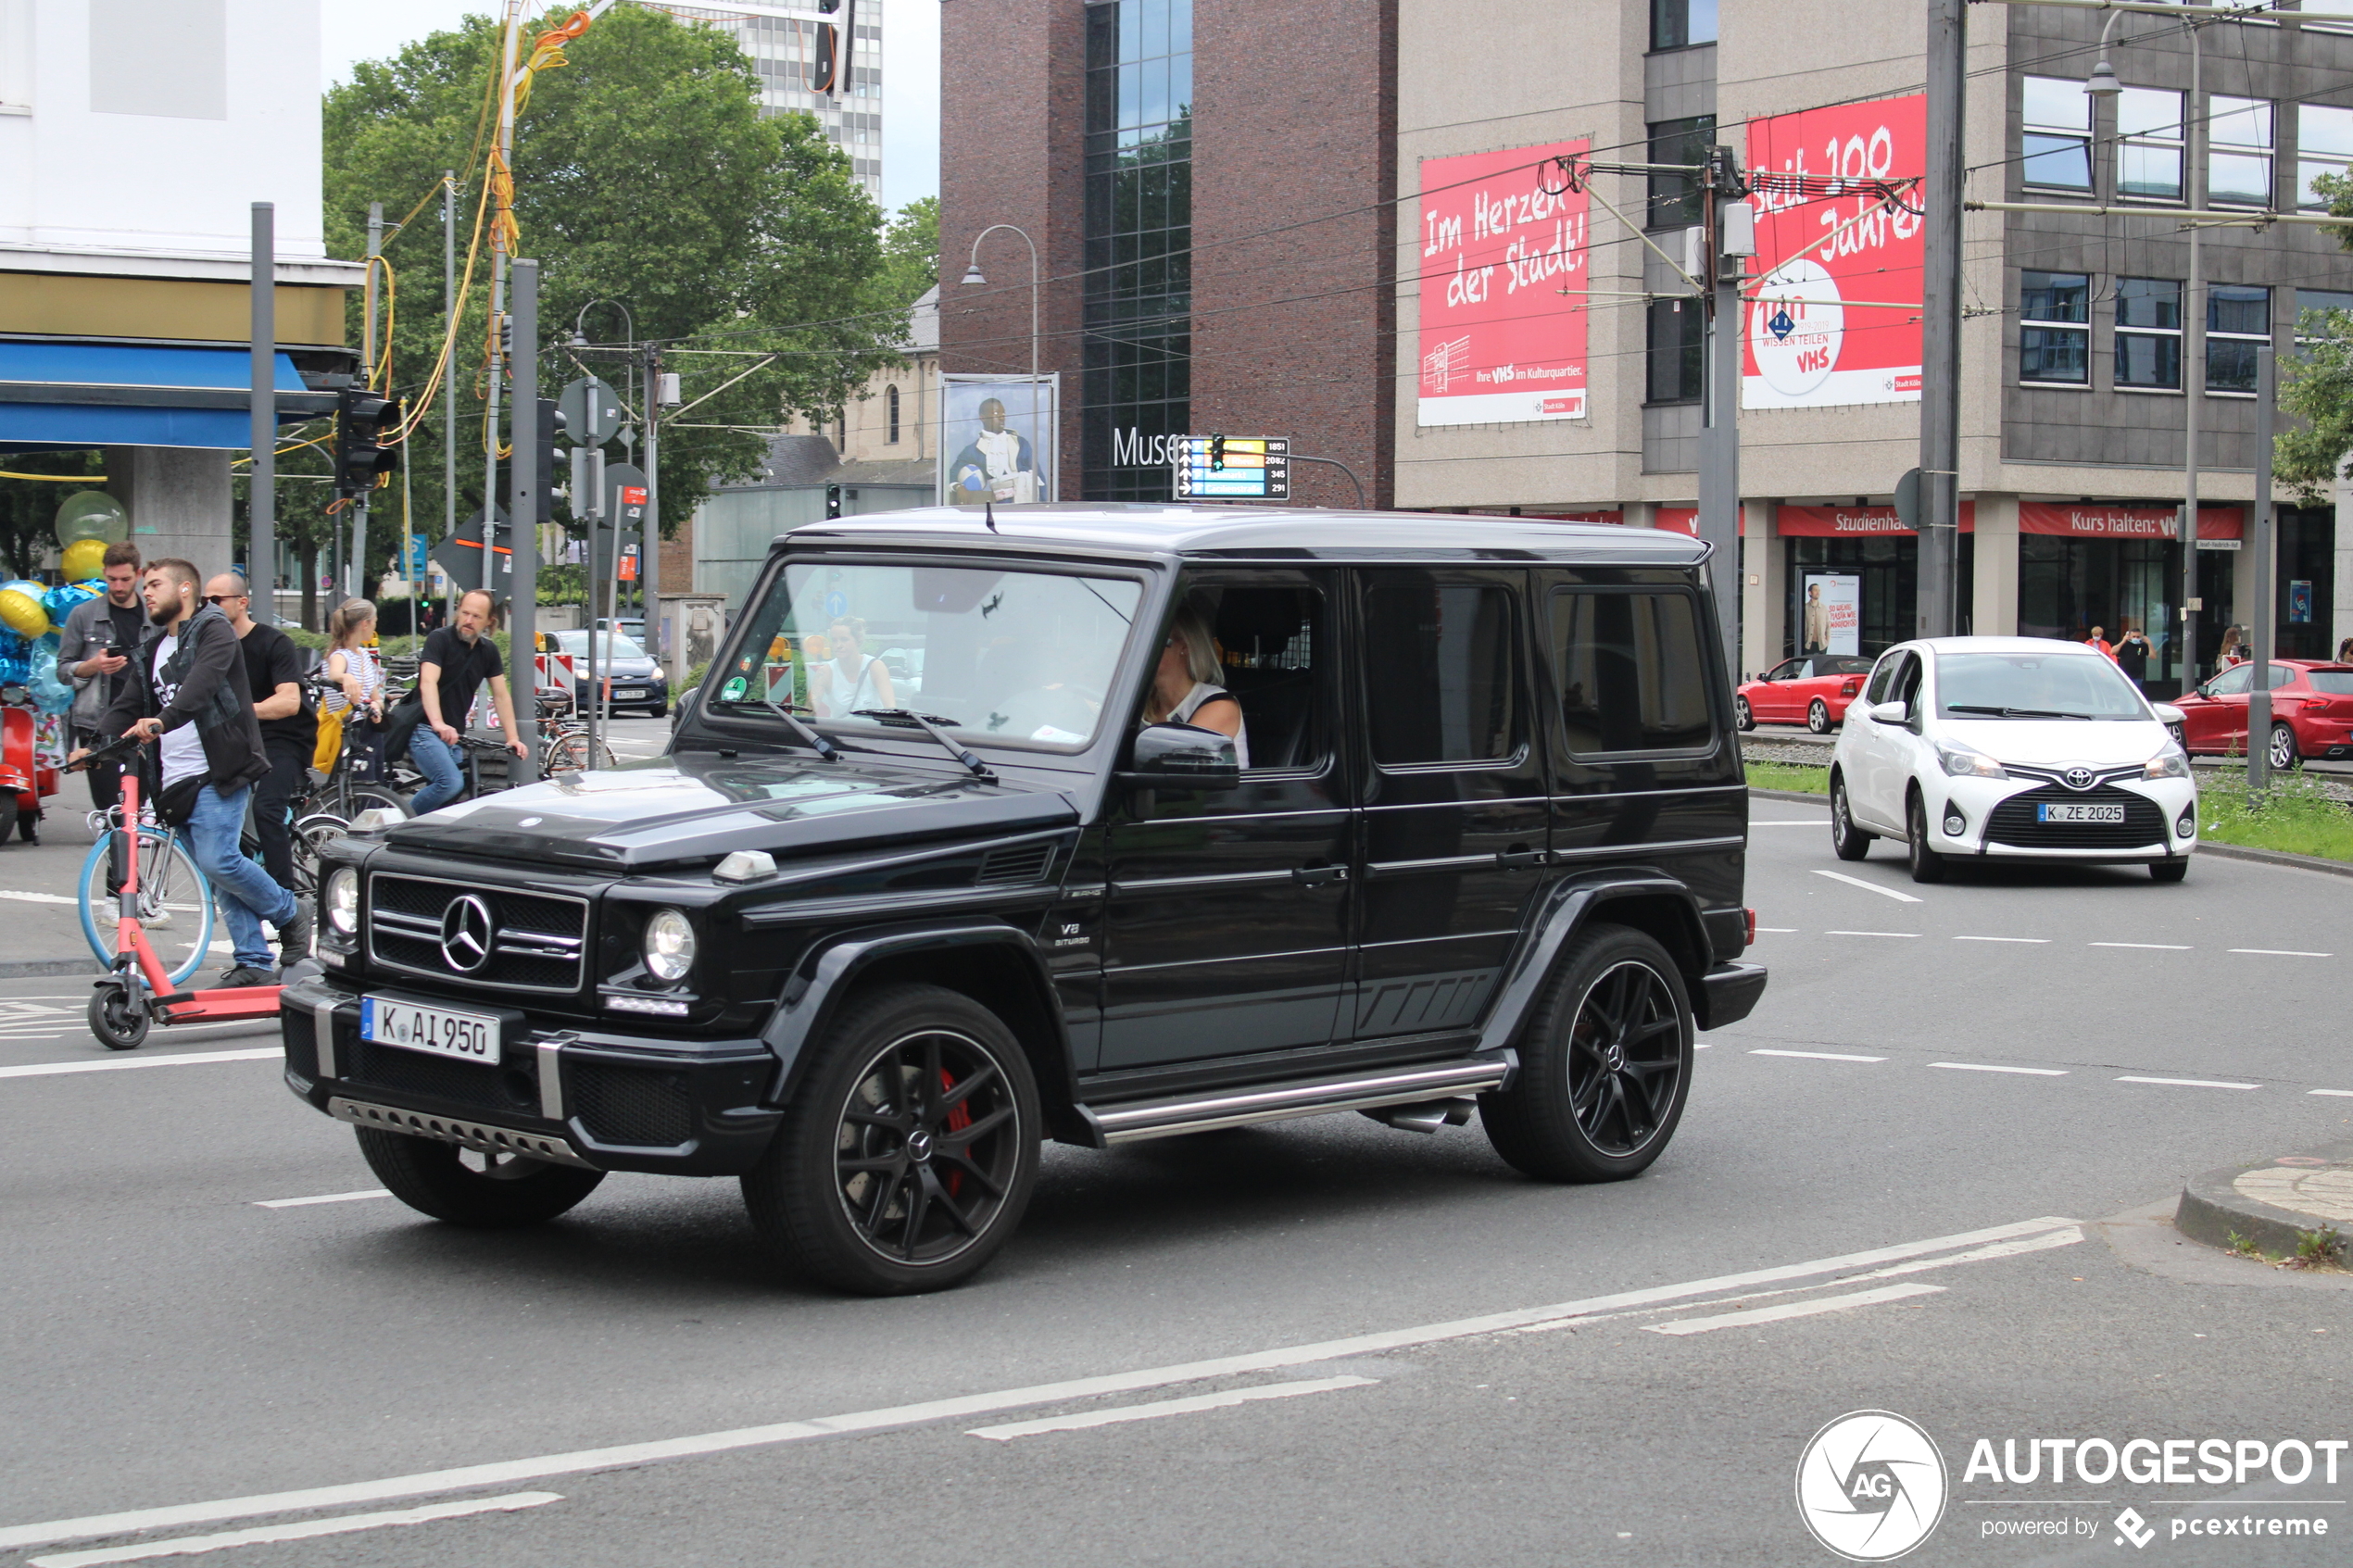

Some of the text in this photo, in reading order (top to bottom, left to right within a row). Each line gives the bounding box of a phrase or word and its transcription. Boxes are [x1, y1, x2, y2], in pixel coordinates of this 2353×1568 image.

[1826, 125, 1892, 194] 100
[1425, 179, 1566, 257] Im Herzen
[1447, 212, 1584, 307] der Stadt!
[1797, 321, 1830, 332] 1919-2019
[1762, 333, 1830, 347] WISSEN TEILEN
[1797, 345, 1830, 373] VHS
[1477, 364, 1582, 384] Ihre VHS im Kulturquartier.
[1909, 379, 1921, 387] Köln
[1265, 457, 1285, 465] 2082
[2071, 512, 2105, 532] Kurs
[2108, 513, 2156, 533] halten:
[732, 679, 740, 690] 4
[130, 810, 138, 833] voi.
[2048, 807, 2057, 820] K
[2067, 807, 2084, 819] ZE
[2088, 807, 2121, 820] 2025
[1061, 923, 1079, 935] V8
[1055, 936, 1089, 947] BITURBO
[384, 1006, 396, 1038] K
